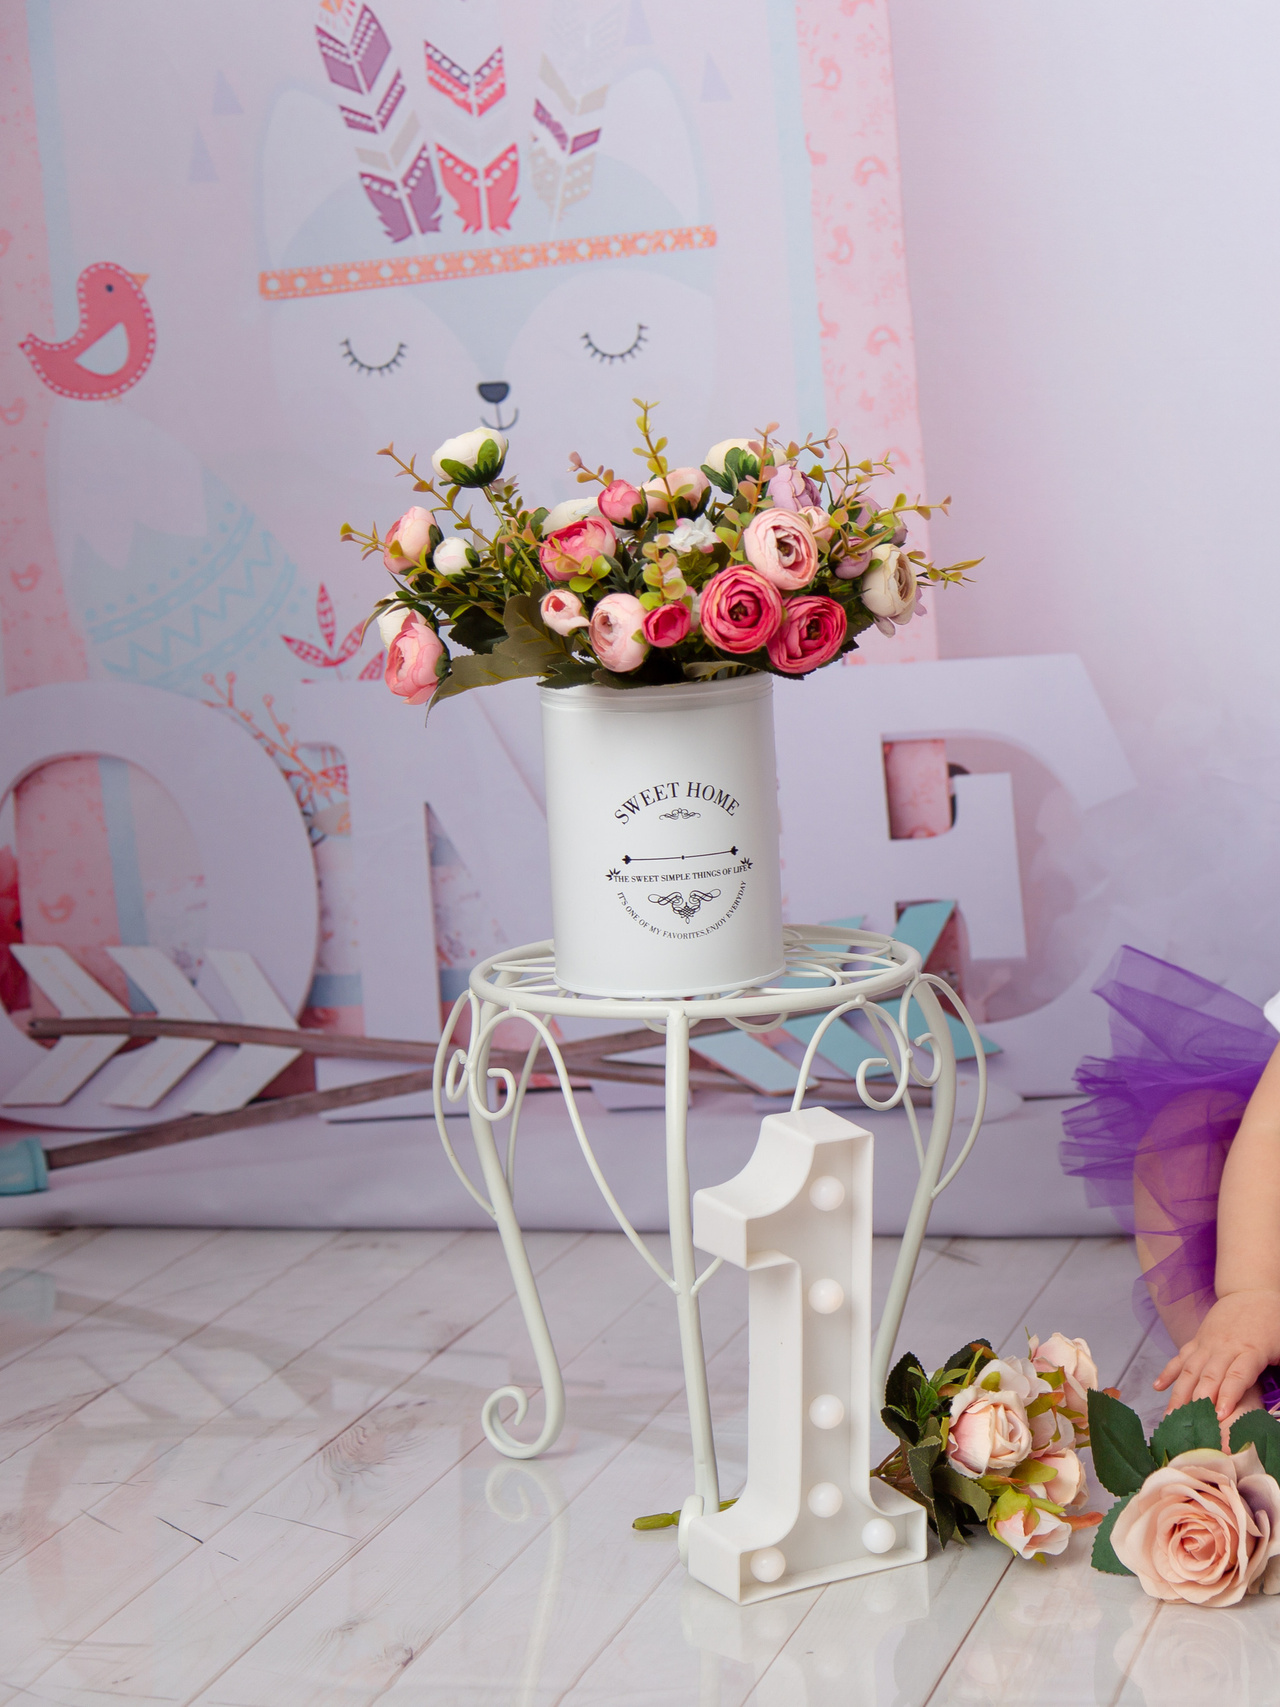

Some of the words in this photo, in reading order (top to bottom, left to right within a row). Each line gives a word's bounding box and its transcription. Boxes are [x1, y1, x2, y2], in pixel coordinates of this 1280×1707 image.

[614, 781, 680, 825] SWEET
[686, 781, 740, 816] HOME
[613, 874, 630, 883] THE
[631, 874, 660, 883] SWEET
[660, 872, 691, 882] SIMPLE
[691, 869, 722, 880] THINGS
[722, 867, 733, 876] OF
[733, 864, 748, 874] LIFE
[625, 905, 639, 922] ONE
[638, 917, 651, 929] OF
[648, 924, 662, 936] MY
[725, 880, 747, 919] EVERYDAY
[688, 1105, 928, 1606] 1
